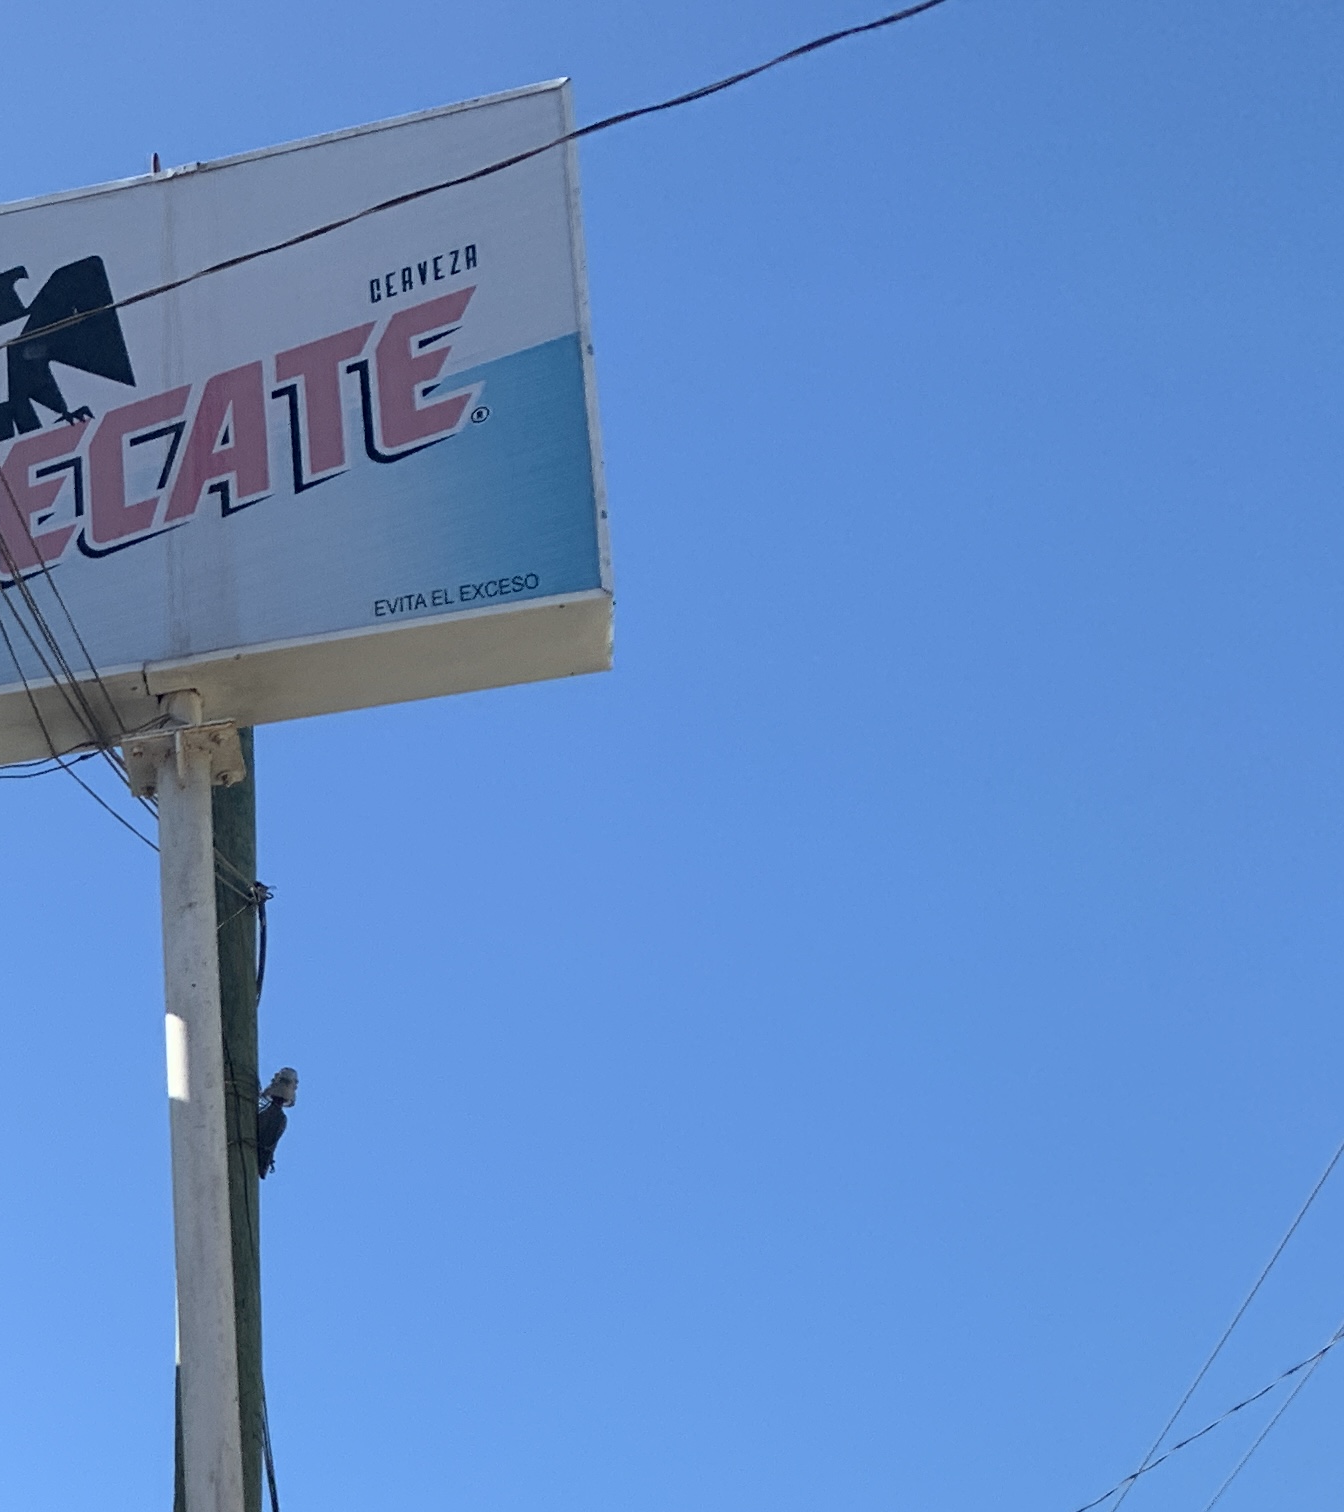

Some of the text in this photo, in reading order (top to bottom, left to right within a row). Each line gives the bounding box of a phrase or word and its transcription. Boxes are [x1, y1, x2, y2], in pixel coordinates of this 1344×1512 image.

[369, 243, 478, 304] CERVEZA
[374, 572, 540, 617] EVITA EL EXCESO
